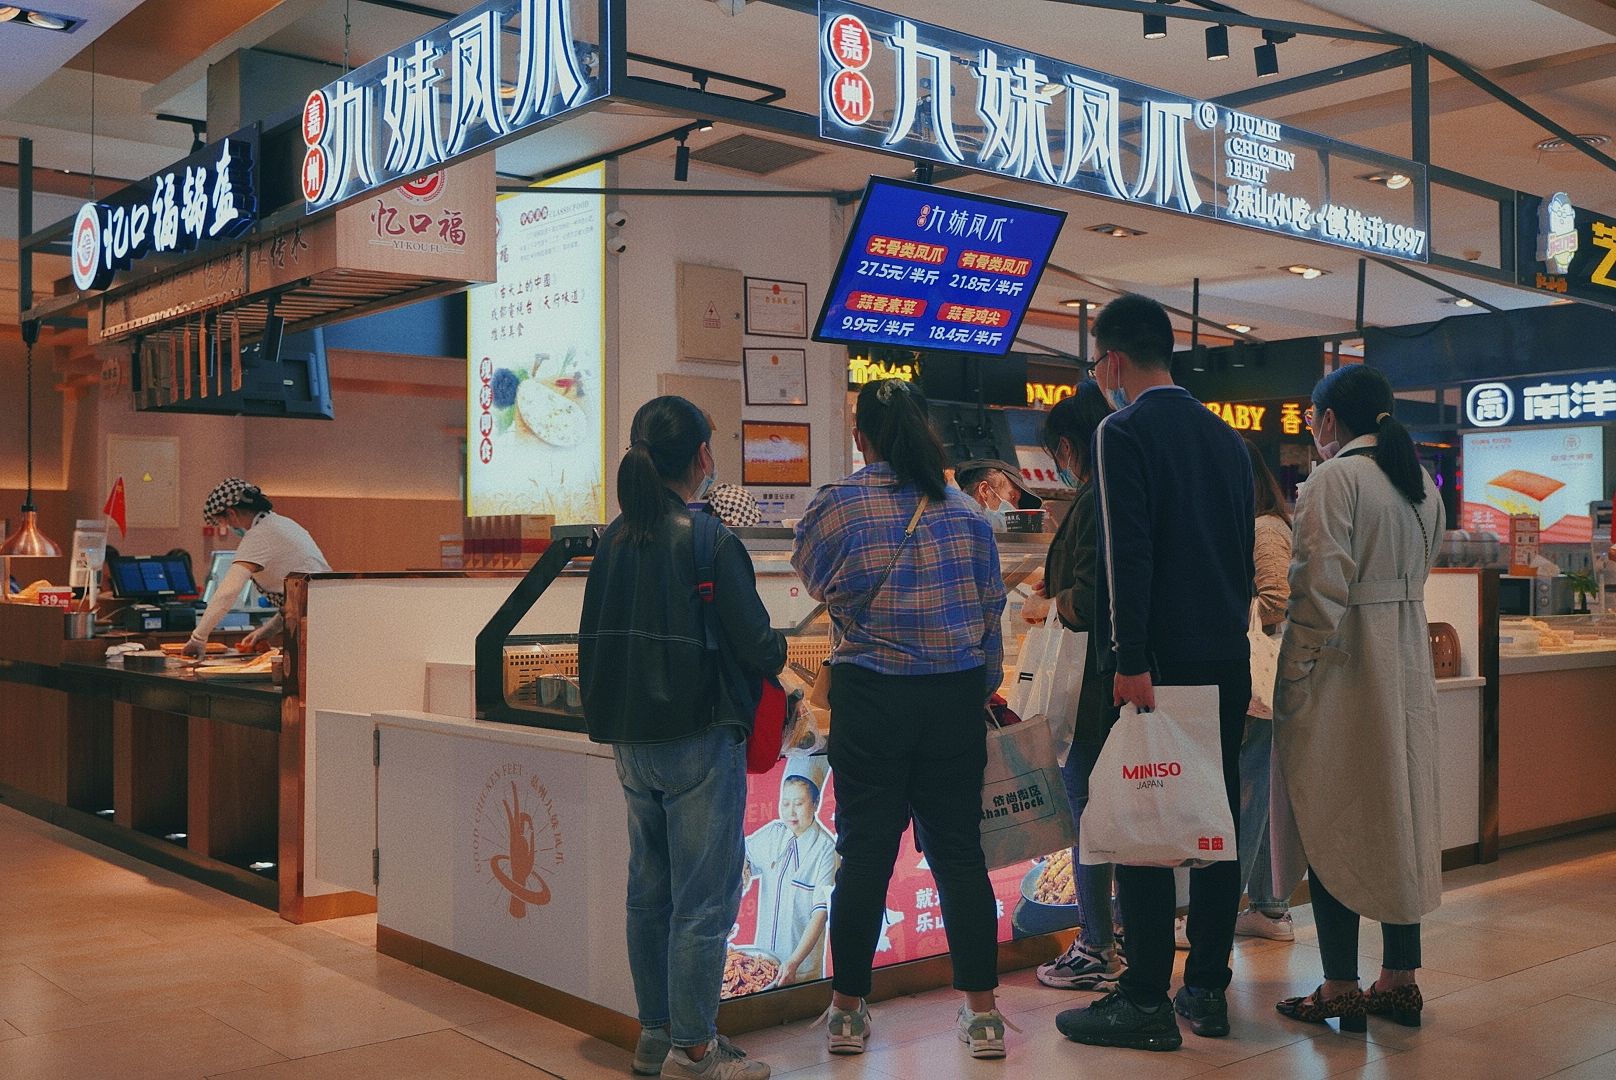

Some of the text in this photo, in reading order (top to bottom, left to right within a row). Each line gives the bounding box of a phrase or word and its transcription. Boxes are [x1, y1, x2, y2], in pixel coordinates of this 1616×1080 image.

[836, 20, 868, 120] 嘉州
[329, 0, 586, 200] 九妹凤爪
[884, 20, 1203, 213] 九妹凤爪
[1227, 112, 1281, 142] JIUMEI
[1227, 138, 1295, 170] CHICKEN
[1228, 160, 1269, 184] FEET
[371, 199, 467, 245] 忆口福
[925, 206, 1007, 244] 九妹凤爪
[870, 237, 1031, 276] 无骨类凤爪 有骨类凤爪
[857, 260, 1024, 297] 27.5元/半斤 21.8元/半斤
[842, 316, 1003, 348] 9.9元/半斤 18.4元/半斤
[1523, 379, 1616, 420] 南洋
[41, 594, 58, 606] 39
[1122, 762, 1182, 780] MINISO
[1136, 780, 1164, 790] JAPAN
